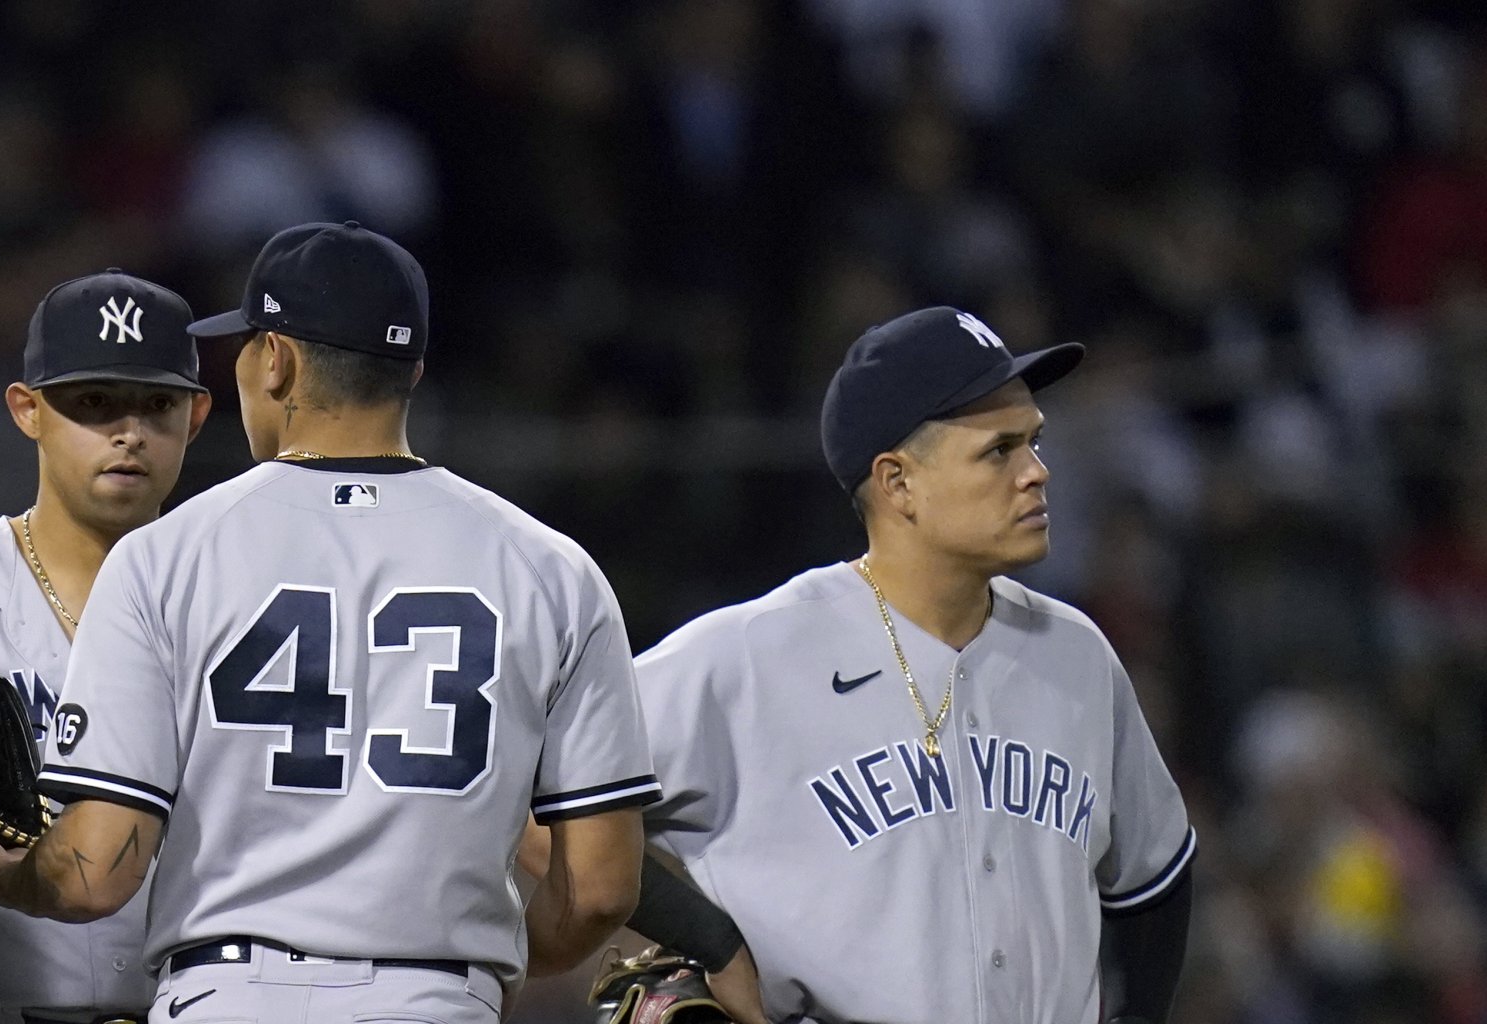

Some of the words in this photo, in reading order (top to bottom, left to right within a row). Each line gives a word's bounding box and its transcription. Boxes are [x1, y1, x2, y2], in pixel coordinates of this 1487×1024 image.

[99, 296, 144, 343] NY
[57, 712, 81, 745] 16
[204, 582, 503, 796] 43
[807, 735, 956, 851] NEW
[967, 733, 1098, 854] YORK
